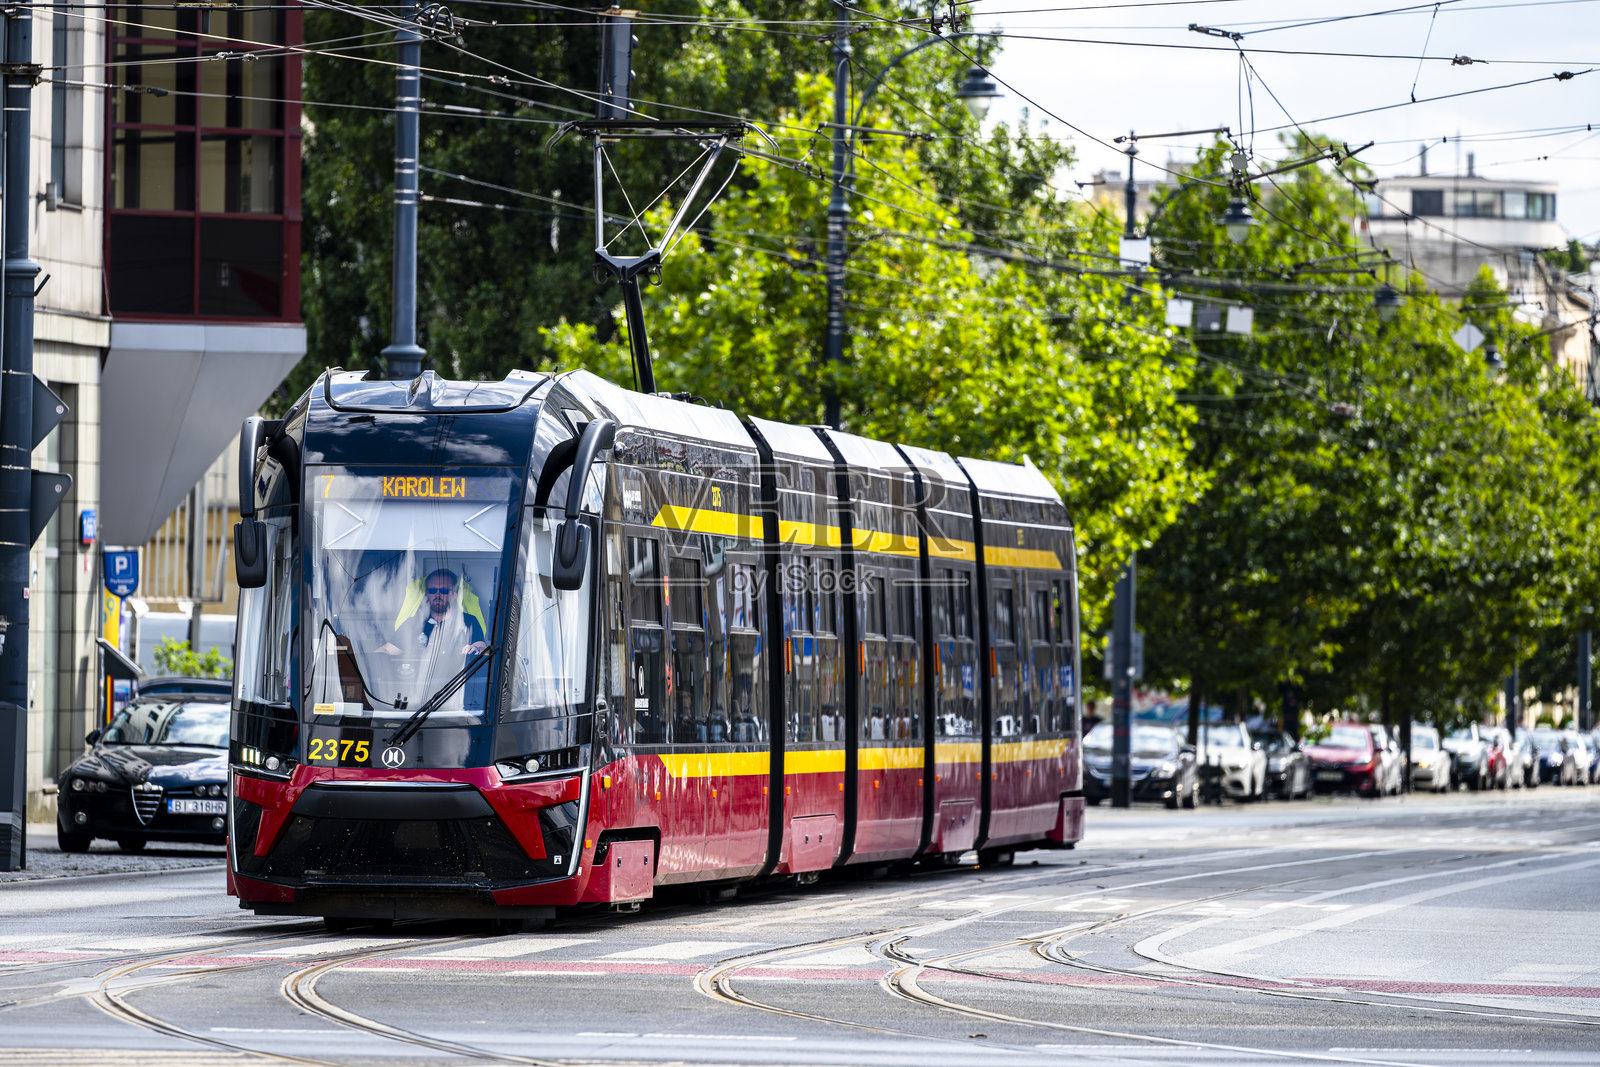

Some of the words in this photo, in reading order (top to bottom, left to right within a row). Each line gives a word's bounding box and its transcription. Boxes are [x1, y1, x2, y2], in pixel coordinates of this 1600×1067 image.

[321, 475, 335, 498] 7
[383, 477, 466, 497] KAROLEW
[115, 556, 128, 575] P
[308, 738, 370, 762] 2375
[175, 801, 187, 811] BI
[193, 801, 224, 812] 318HR
